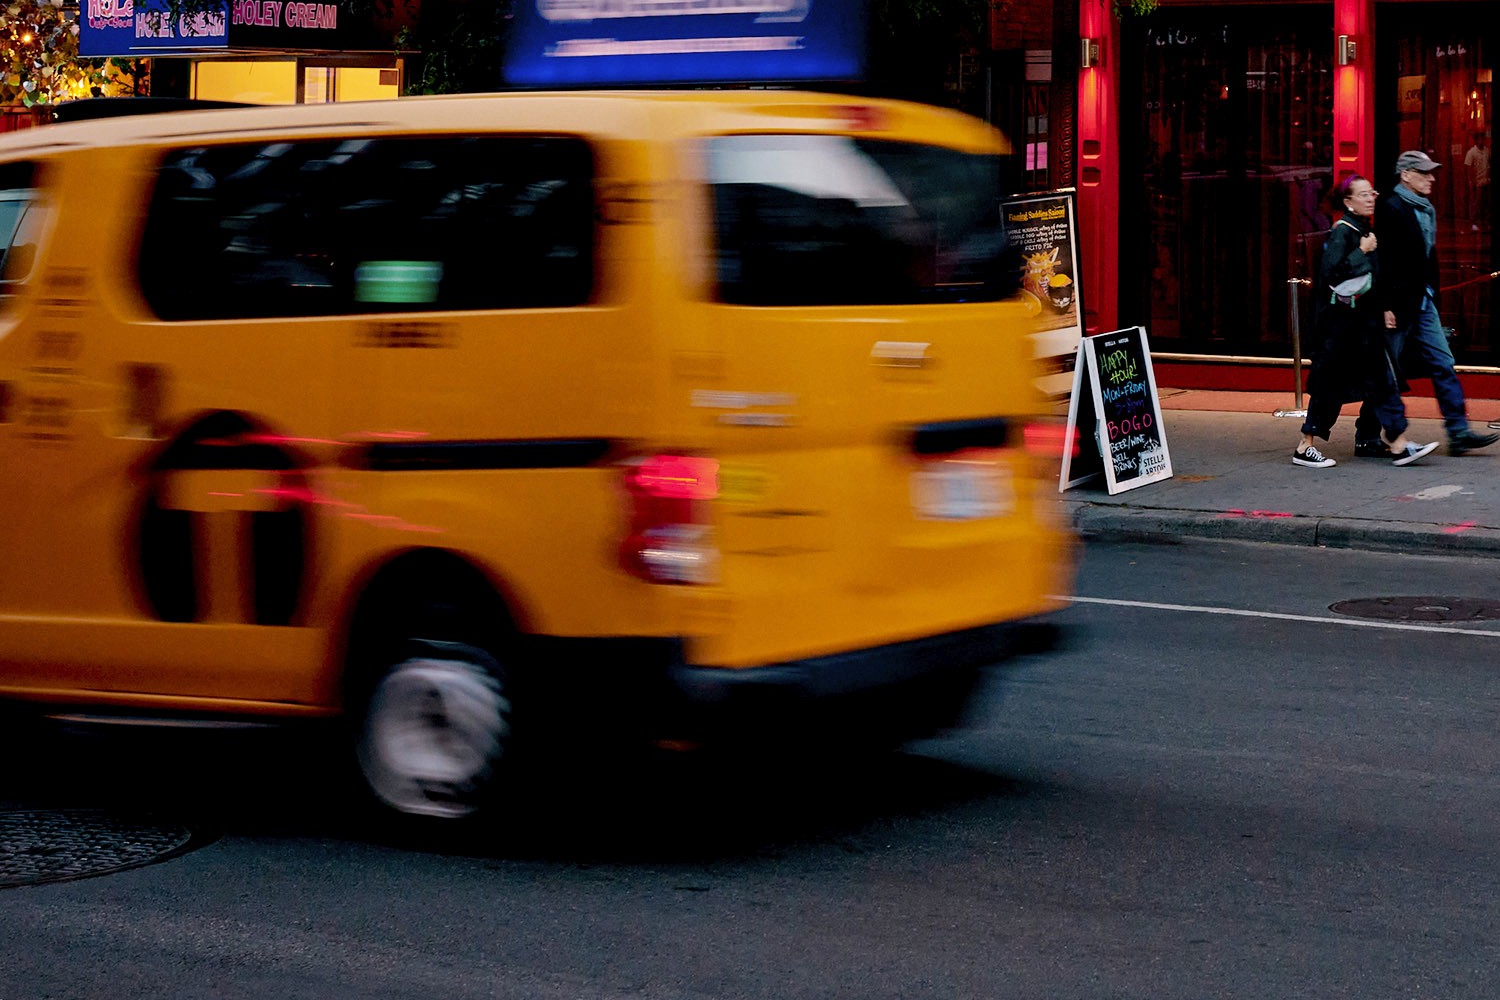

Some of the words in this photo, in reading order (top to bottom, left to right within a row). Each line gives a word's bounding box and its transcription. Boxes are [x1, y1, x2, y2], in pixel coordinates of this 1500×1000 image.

[233, 0, 282, 27] HOLEY
[285, 2, 337, 29] CREAM
[1100, 350, 1128, 375] HAPPY
